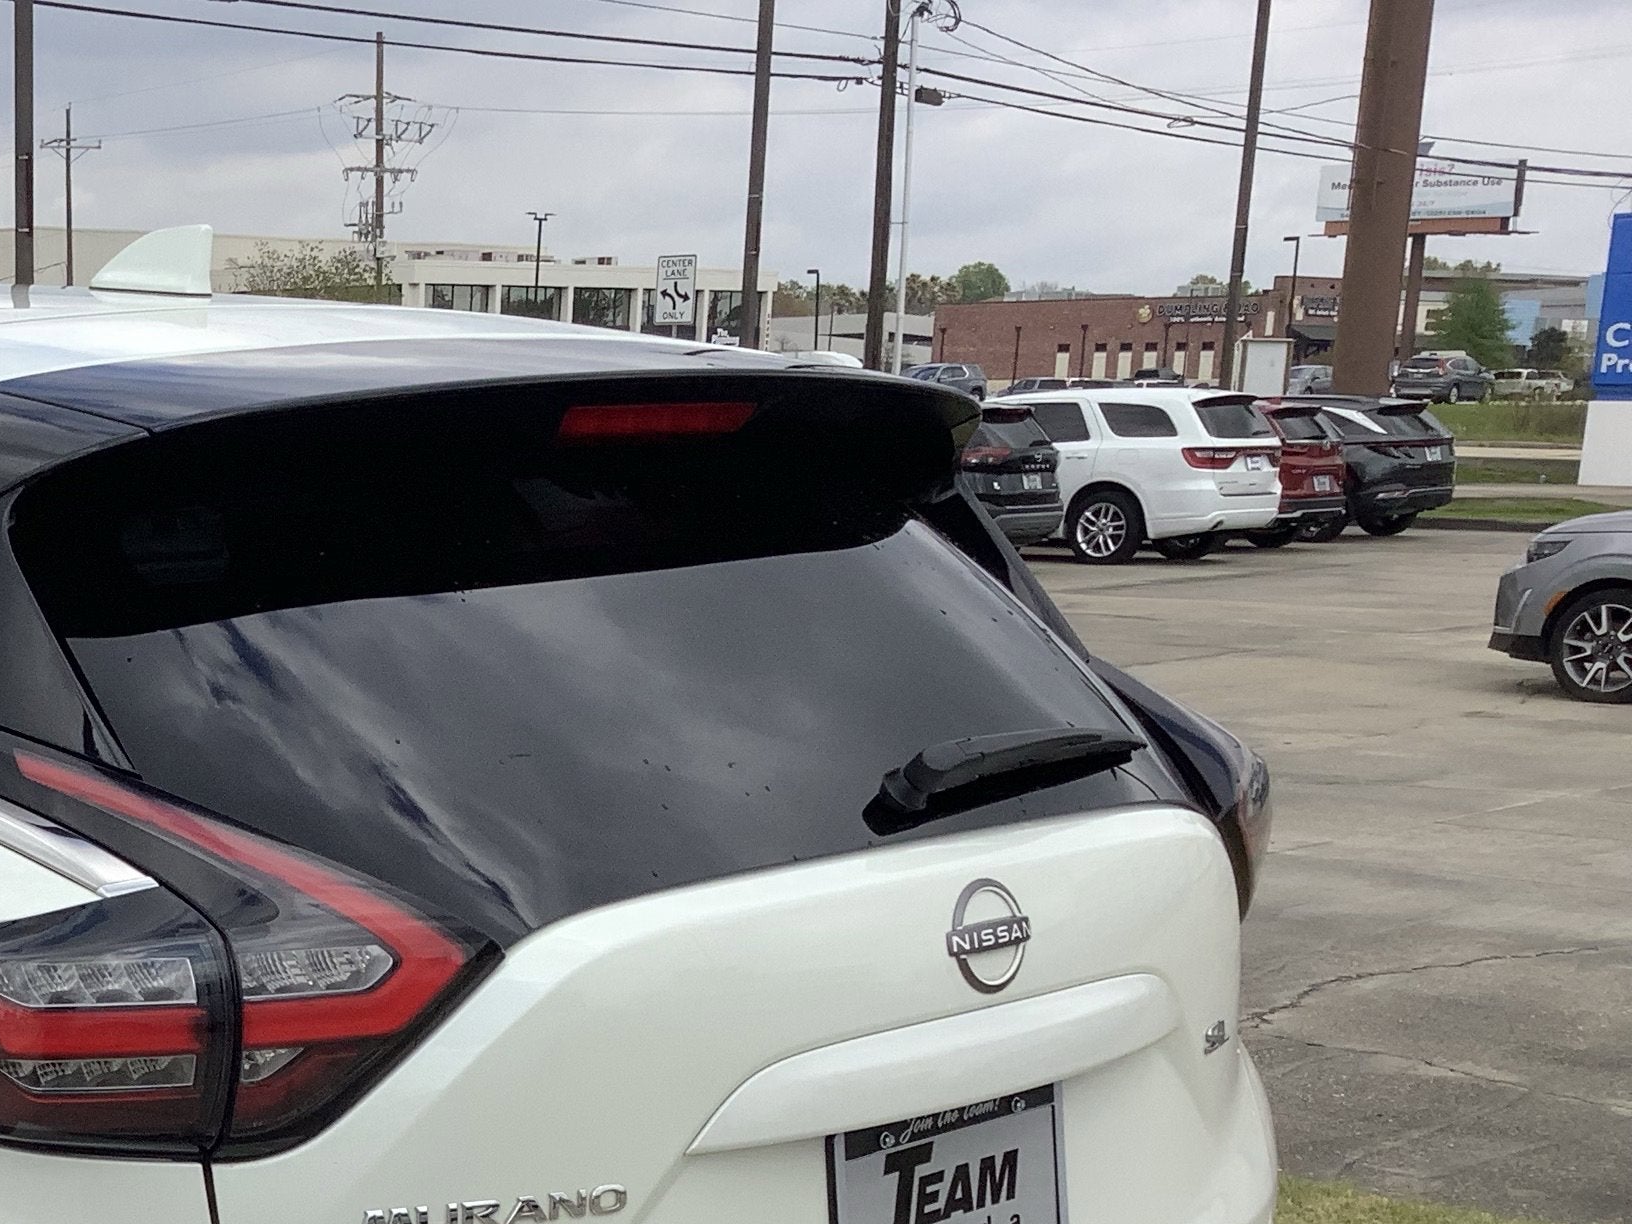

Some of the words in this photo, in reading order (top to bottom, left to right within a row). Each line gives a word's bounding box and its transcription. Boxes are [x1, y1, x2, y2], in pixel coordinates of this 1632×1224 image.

[1422, 178, 1479, 188] Substance
[1482, 177, 1503, 187] Use
[661, 259, 693, 269] CENTER
[665, 269, 687, 277] LANE
[662, 311, 685, 320] ONLY
[950, 920, 1032, 954] NISSAN
[899, 1117, 934, 1144] Join
